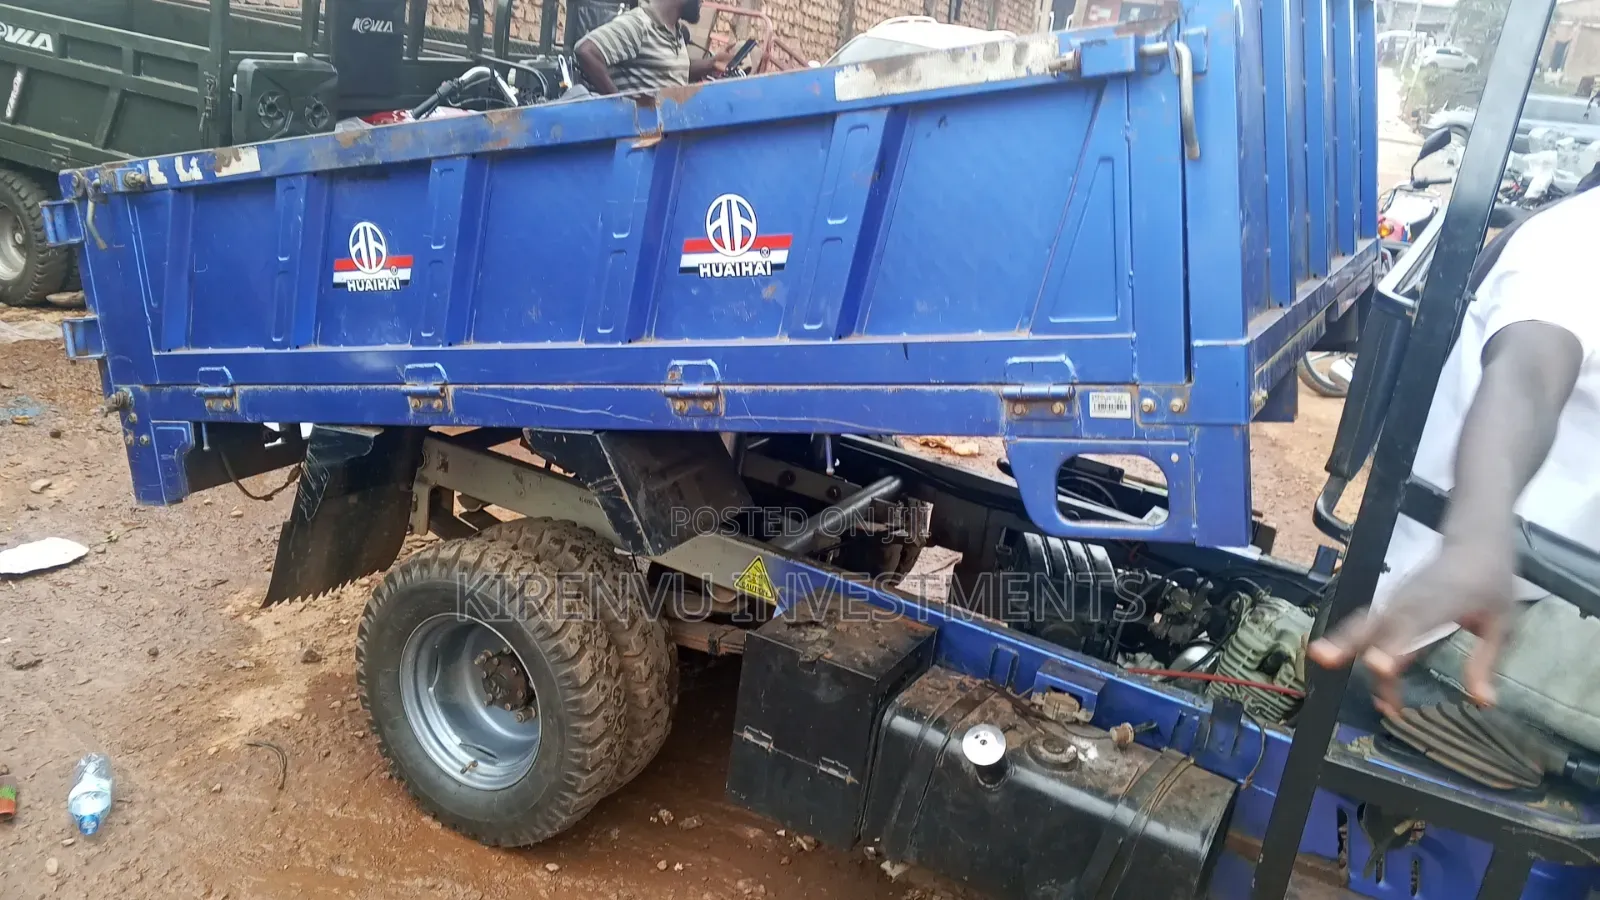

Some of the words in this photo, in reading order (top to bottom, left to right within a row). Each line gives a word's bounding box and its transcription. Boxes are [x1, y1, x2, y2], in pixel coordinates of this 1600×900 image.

[698, 260, 772, 278] HUAIHAI
[346, 277, 400, 292] HUAIHAI
[741, 581, 769, 597] CAUTION
